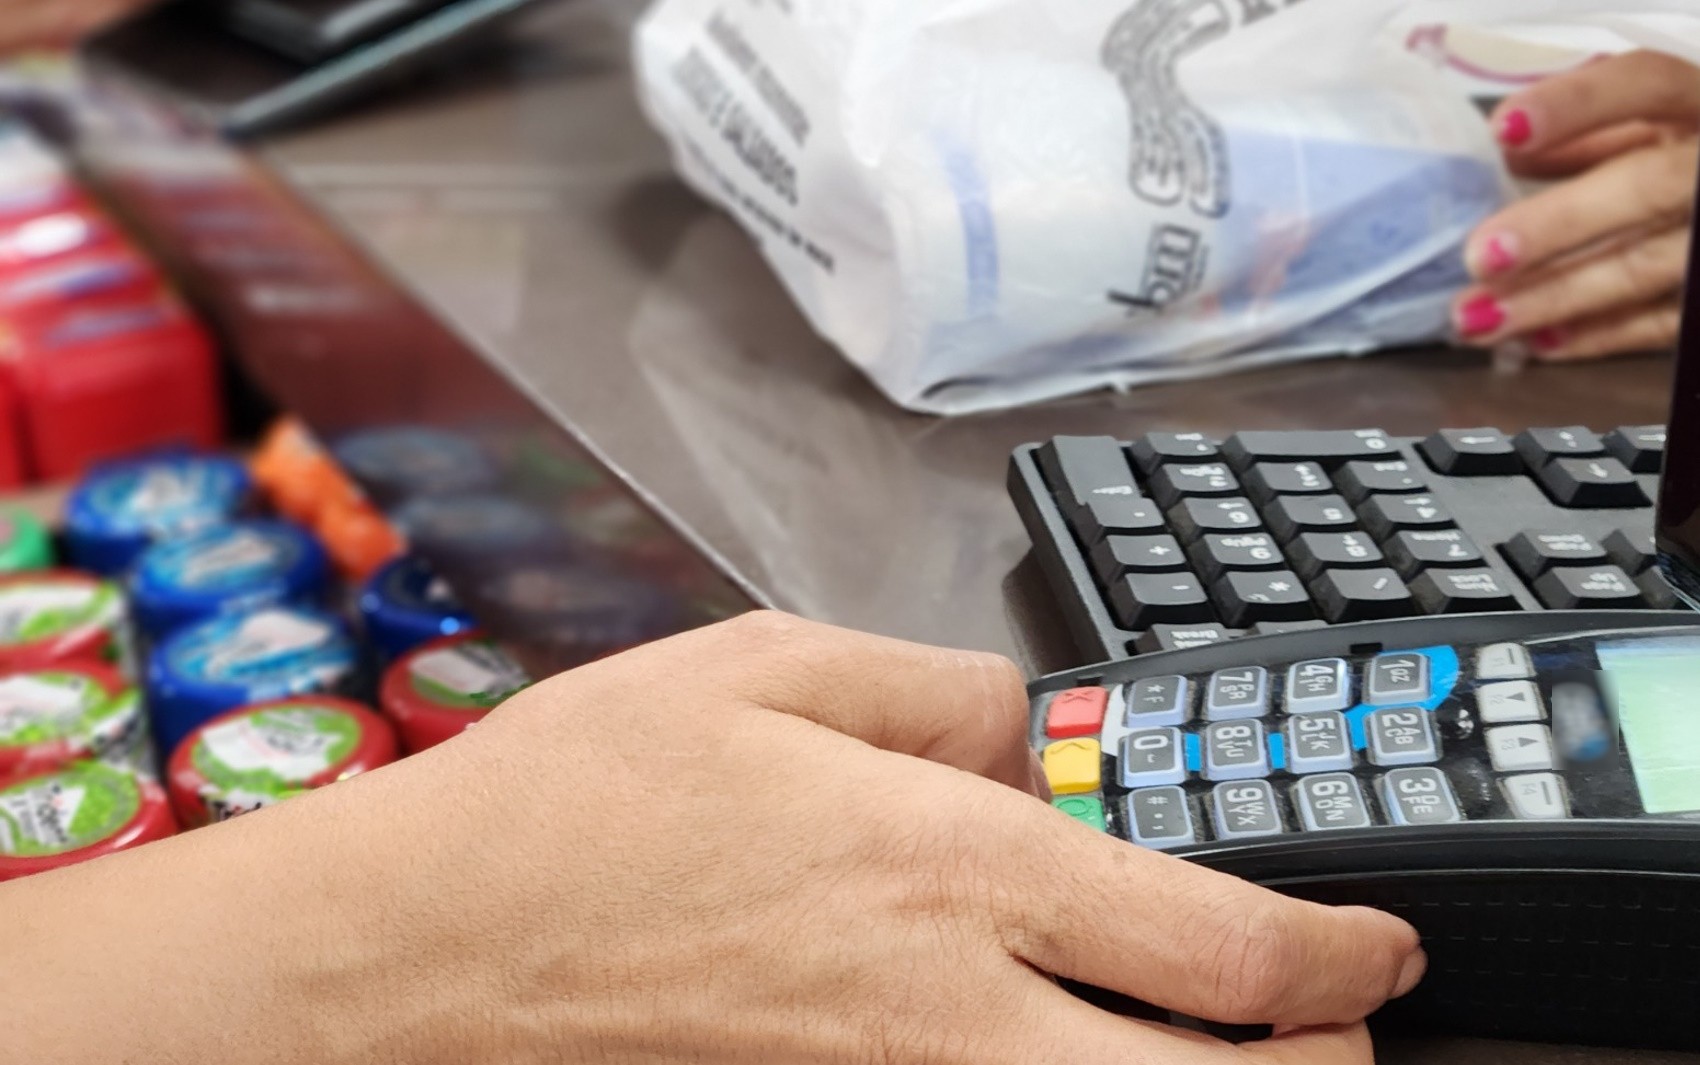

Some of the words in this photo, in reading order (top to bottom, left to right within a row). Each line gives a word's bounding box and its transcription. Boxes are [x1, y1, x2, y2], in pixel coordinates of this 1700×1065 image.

[1219, 671, 1254, 682] 7
[1300, 664, 1334, 677] 4
[1300, 718, 1335, 731] 5
[1382, 713, 1418, 727] 2
[1216, 725, 1251, 740] 8
[1312, 780, 1348, 796] 6
[1399, 777, 1437, 794] 3
[1226, 787, 1263, 802] 9
